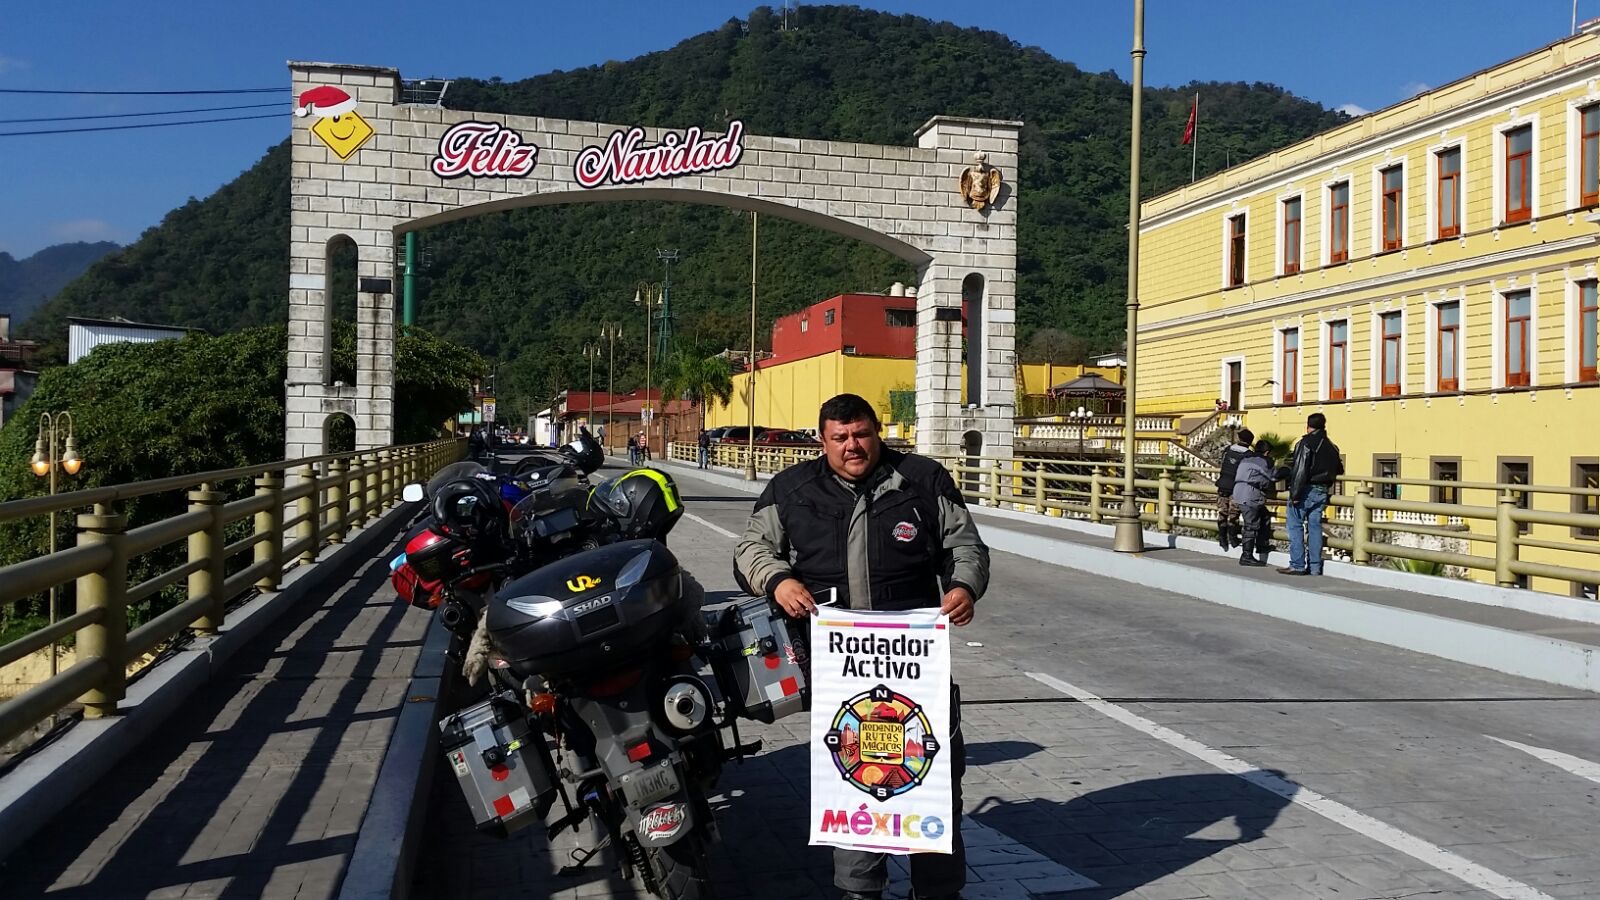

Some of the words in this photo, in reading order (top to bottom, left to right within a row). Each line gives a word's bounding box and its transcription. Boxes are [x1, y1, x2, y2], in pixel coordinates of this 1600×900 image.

[433, 121, 538, 178] Feliz
[575, 120, 743, 187] Navidad
[573, 595, 611, 615] SHAD
[829, 631, 935, 657] Rodador
[842, 655, 921, 680] Activo
[876, 690, 888, 698] N
[828, 735, 838, 744] O
[926, 742, 936, 751] E
[877, 787, 887, 796] S
[820, 803, 945, 840] México
